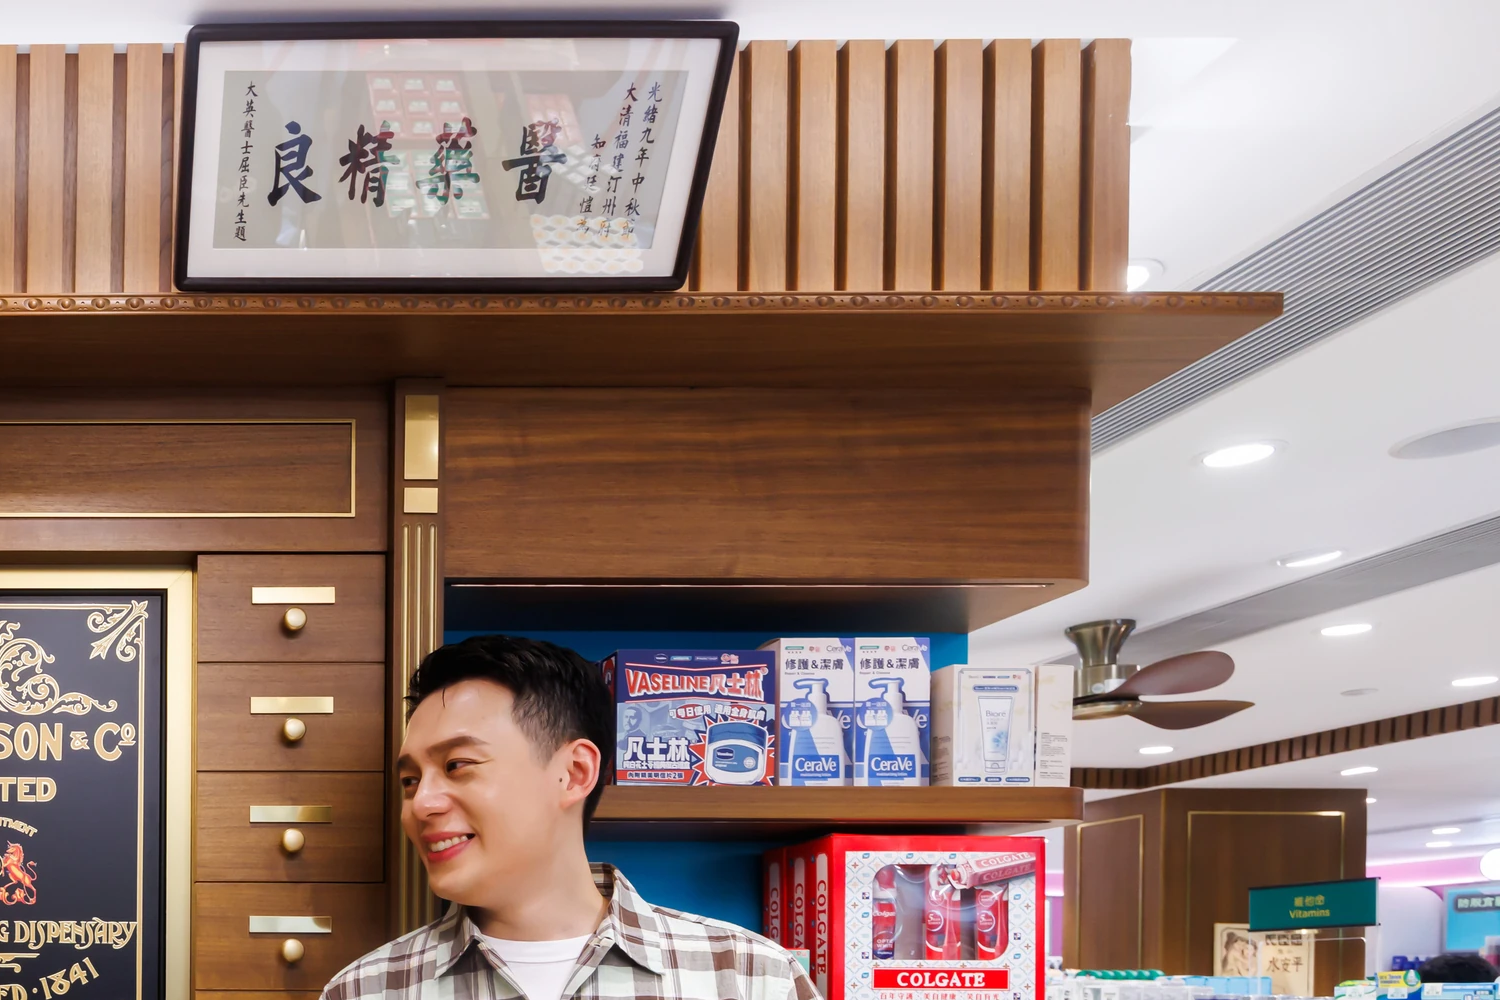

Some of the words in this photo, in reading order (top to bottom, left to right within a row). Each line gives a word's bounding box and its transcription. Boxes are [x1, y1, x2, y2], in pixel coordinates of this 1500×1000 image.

[826, 645, 852, 653] CeraVe
[902, 644, 928, 652] CeraVe
[625, 668, 710, 697] VASELINE
[708, 669, 765, 701] 凡士林
[70, 731, 90, 750] &
[623, 736, 690, 762] 凡士林
[795, 757, 837, 772] CeraVe
[871, 757, 912, 771] CeraVe
[980, 852, 1032, 867] COLGATE
[770, 887, 778, 940] COLG
[795, 883, 804, 948] COLGA
[1290, 909, 1330, 919] Vitamins
[14, 916, 137, 949] DISPENSARY
[817, 880, 827, 974] COLGATE
[40, 956, 100, 1000] 1841
[897, 972, 986, 987] COLGATE
